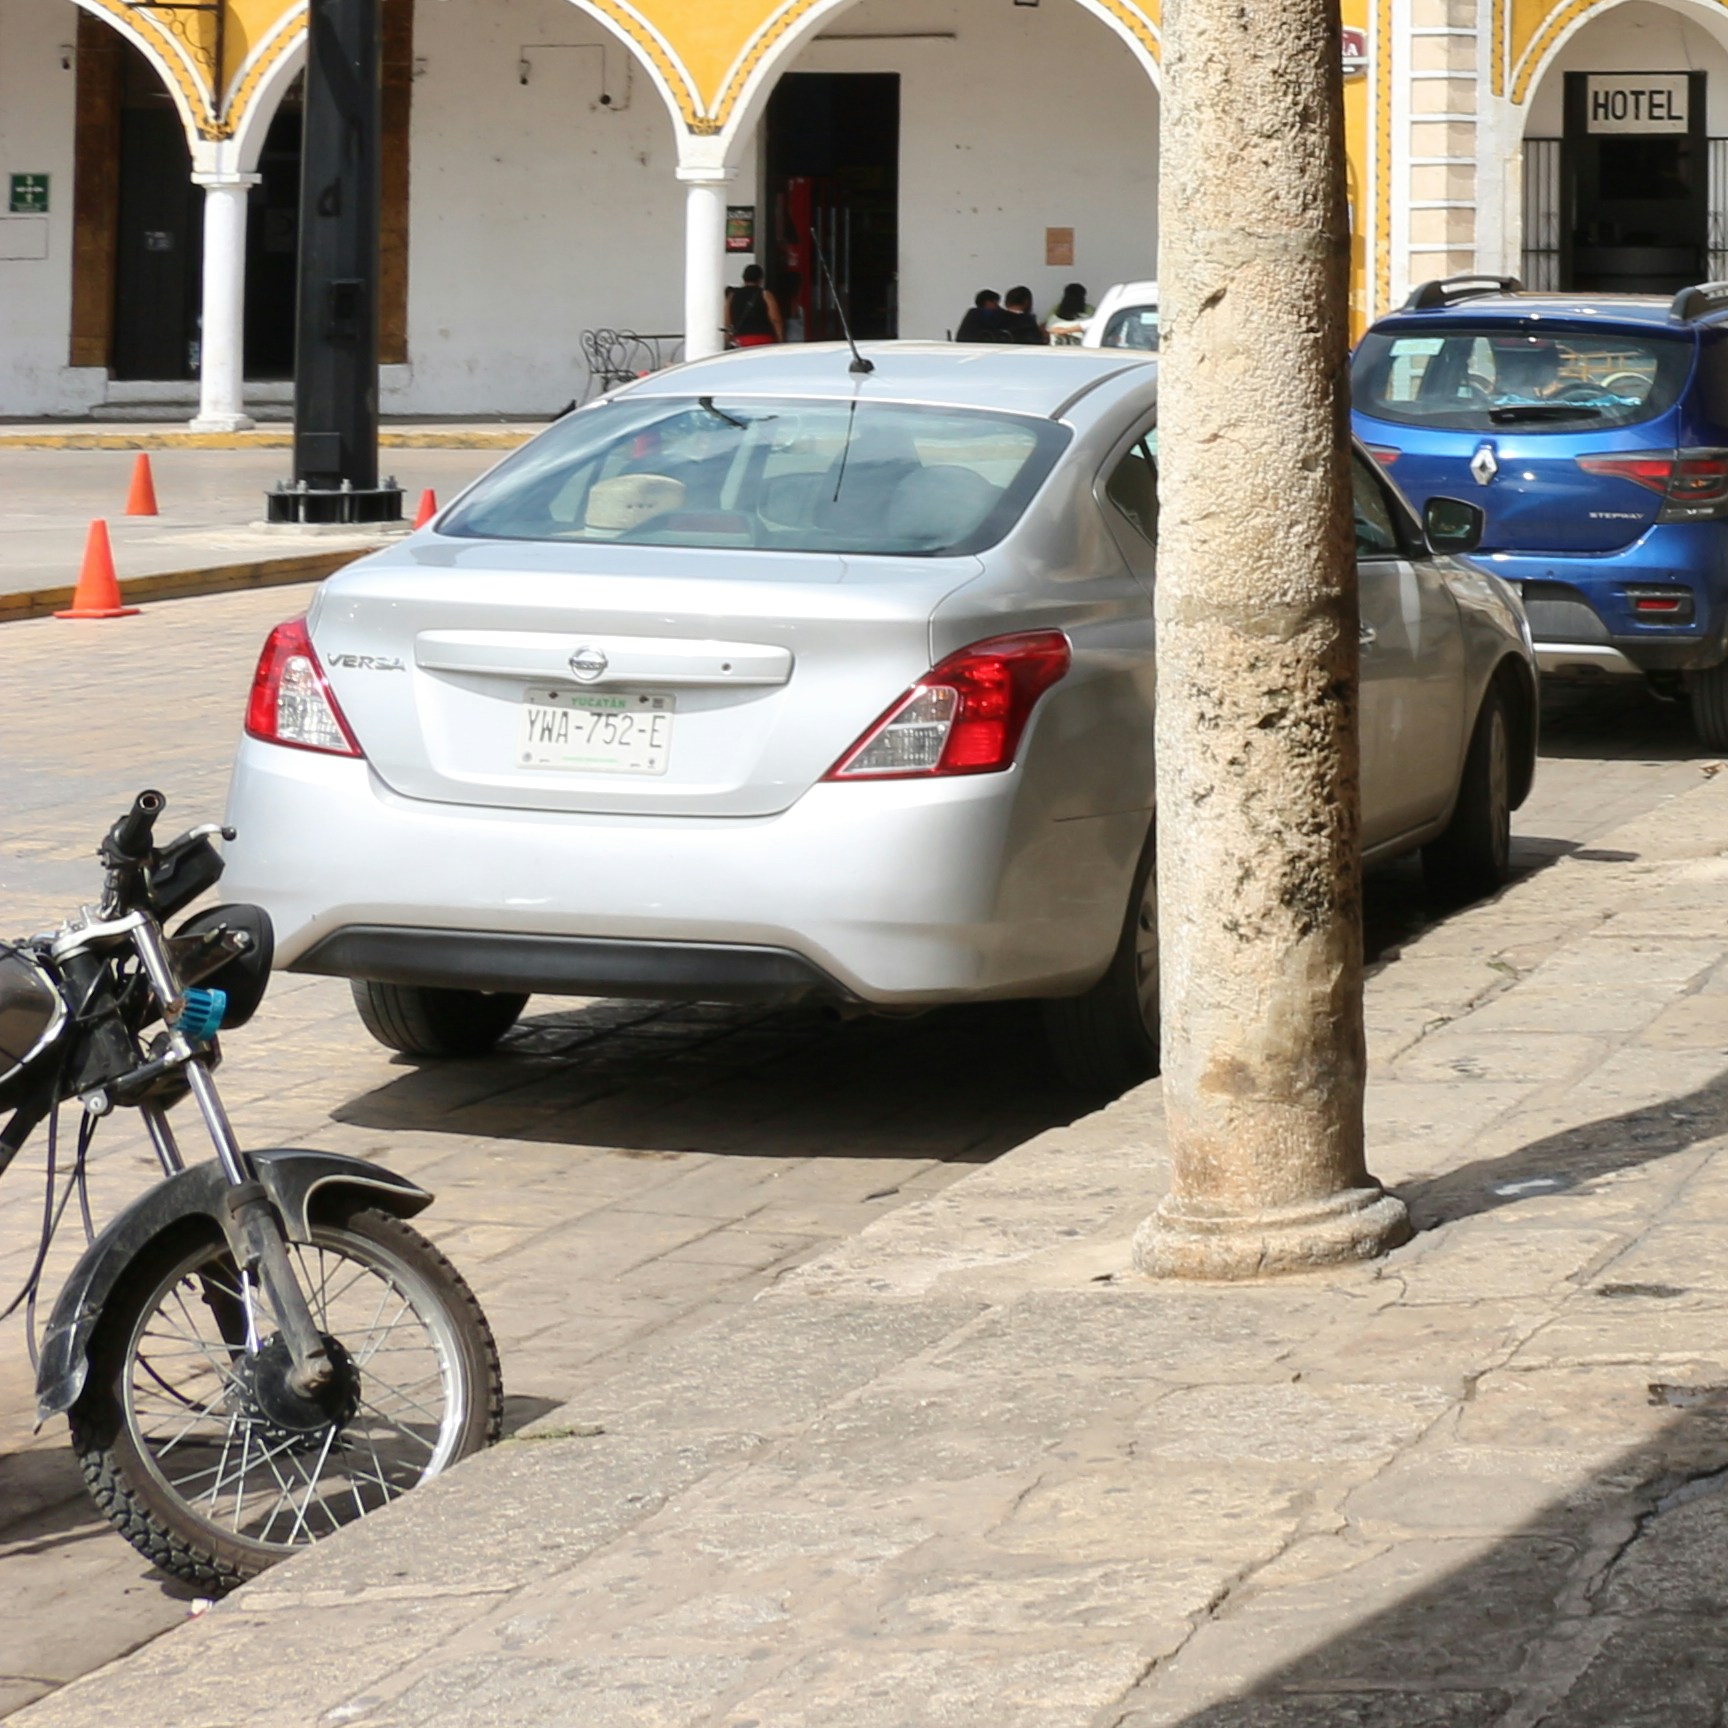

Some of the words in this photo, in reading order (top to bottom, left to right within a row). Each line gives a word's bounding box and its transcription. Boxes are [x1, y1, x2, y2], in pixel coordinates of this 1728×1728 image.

[1592, 89, 1684, 123] HOTEL
[1588, 511, 1645, 520] STEPWAY
[326, 653, 406, 672] VERSA
[571, 696, 628, 709] YUCATÁN
[527, 708, 667, 749] YWA-752-E
